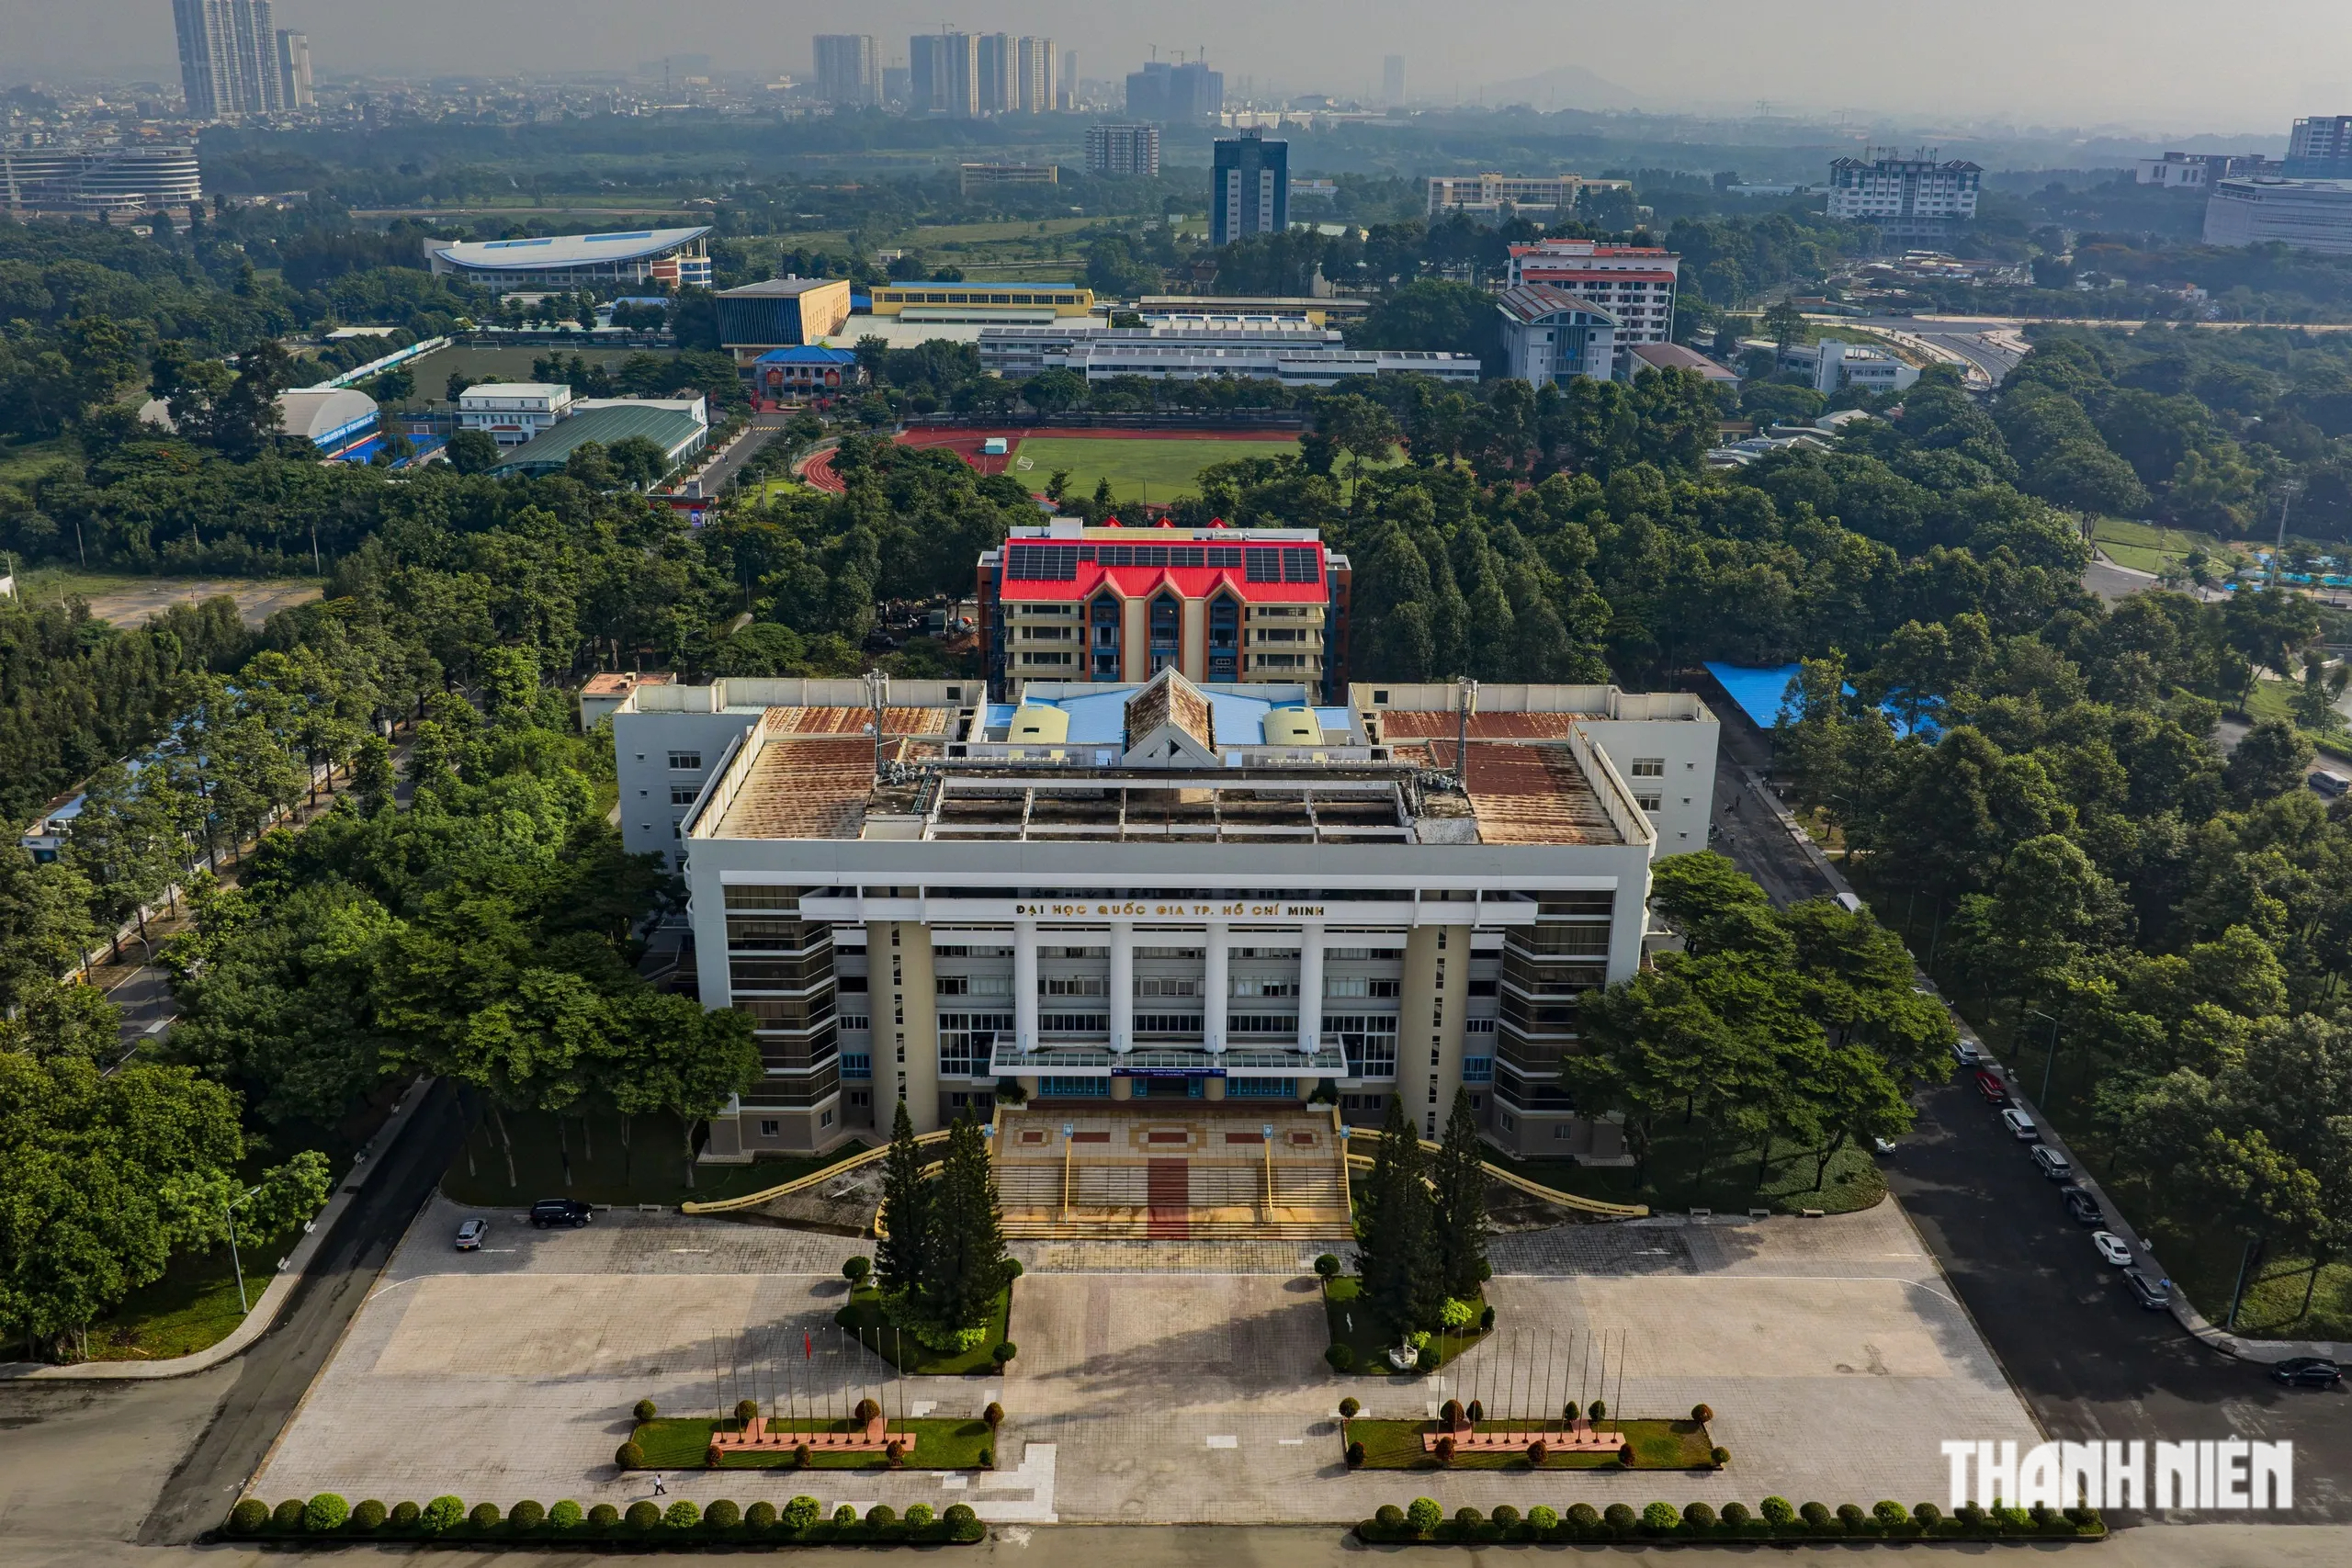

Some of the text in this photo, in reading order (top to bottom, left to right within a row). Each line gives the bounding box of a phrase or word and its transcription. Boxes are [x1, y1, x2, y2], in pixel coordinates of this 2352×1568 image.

[1015, 905, 1044, 916] ĐẠI
[1052, 905, 1087, 916] HỌC
[1097, 901, 1146, 915] QUỐC
[1156, 905, 1184, 915] GIA
[1193, 905, 1215, 916] TP.
[1251, 902, 1280, 916] CHÍ
[1288, 906, 1325, 916] MINH
